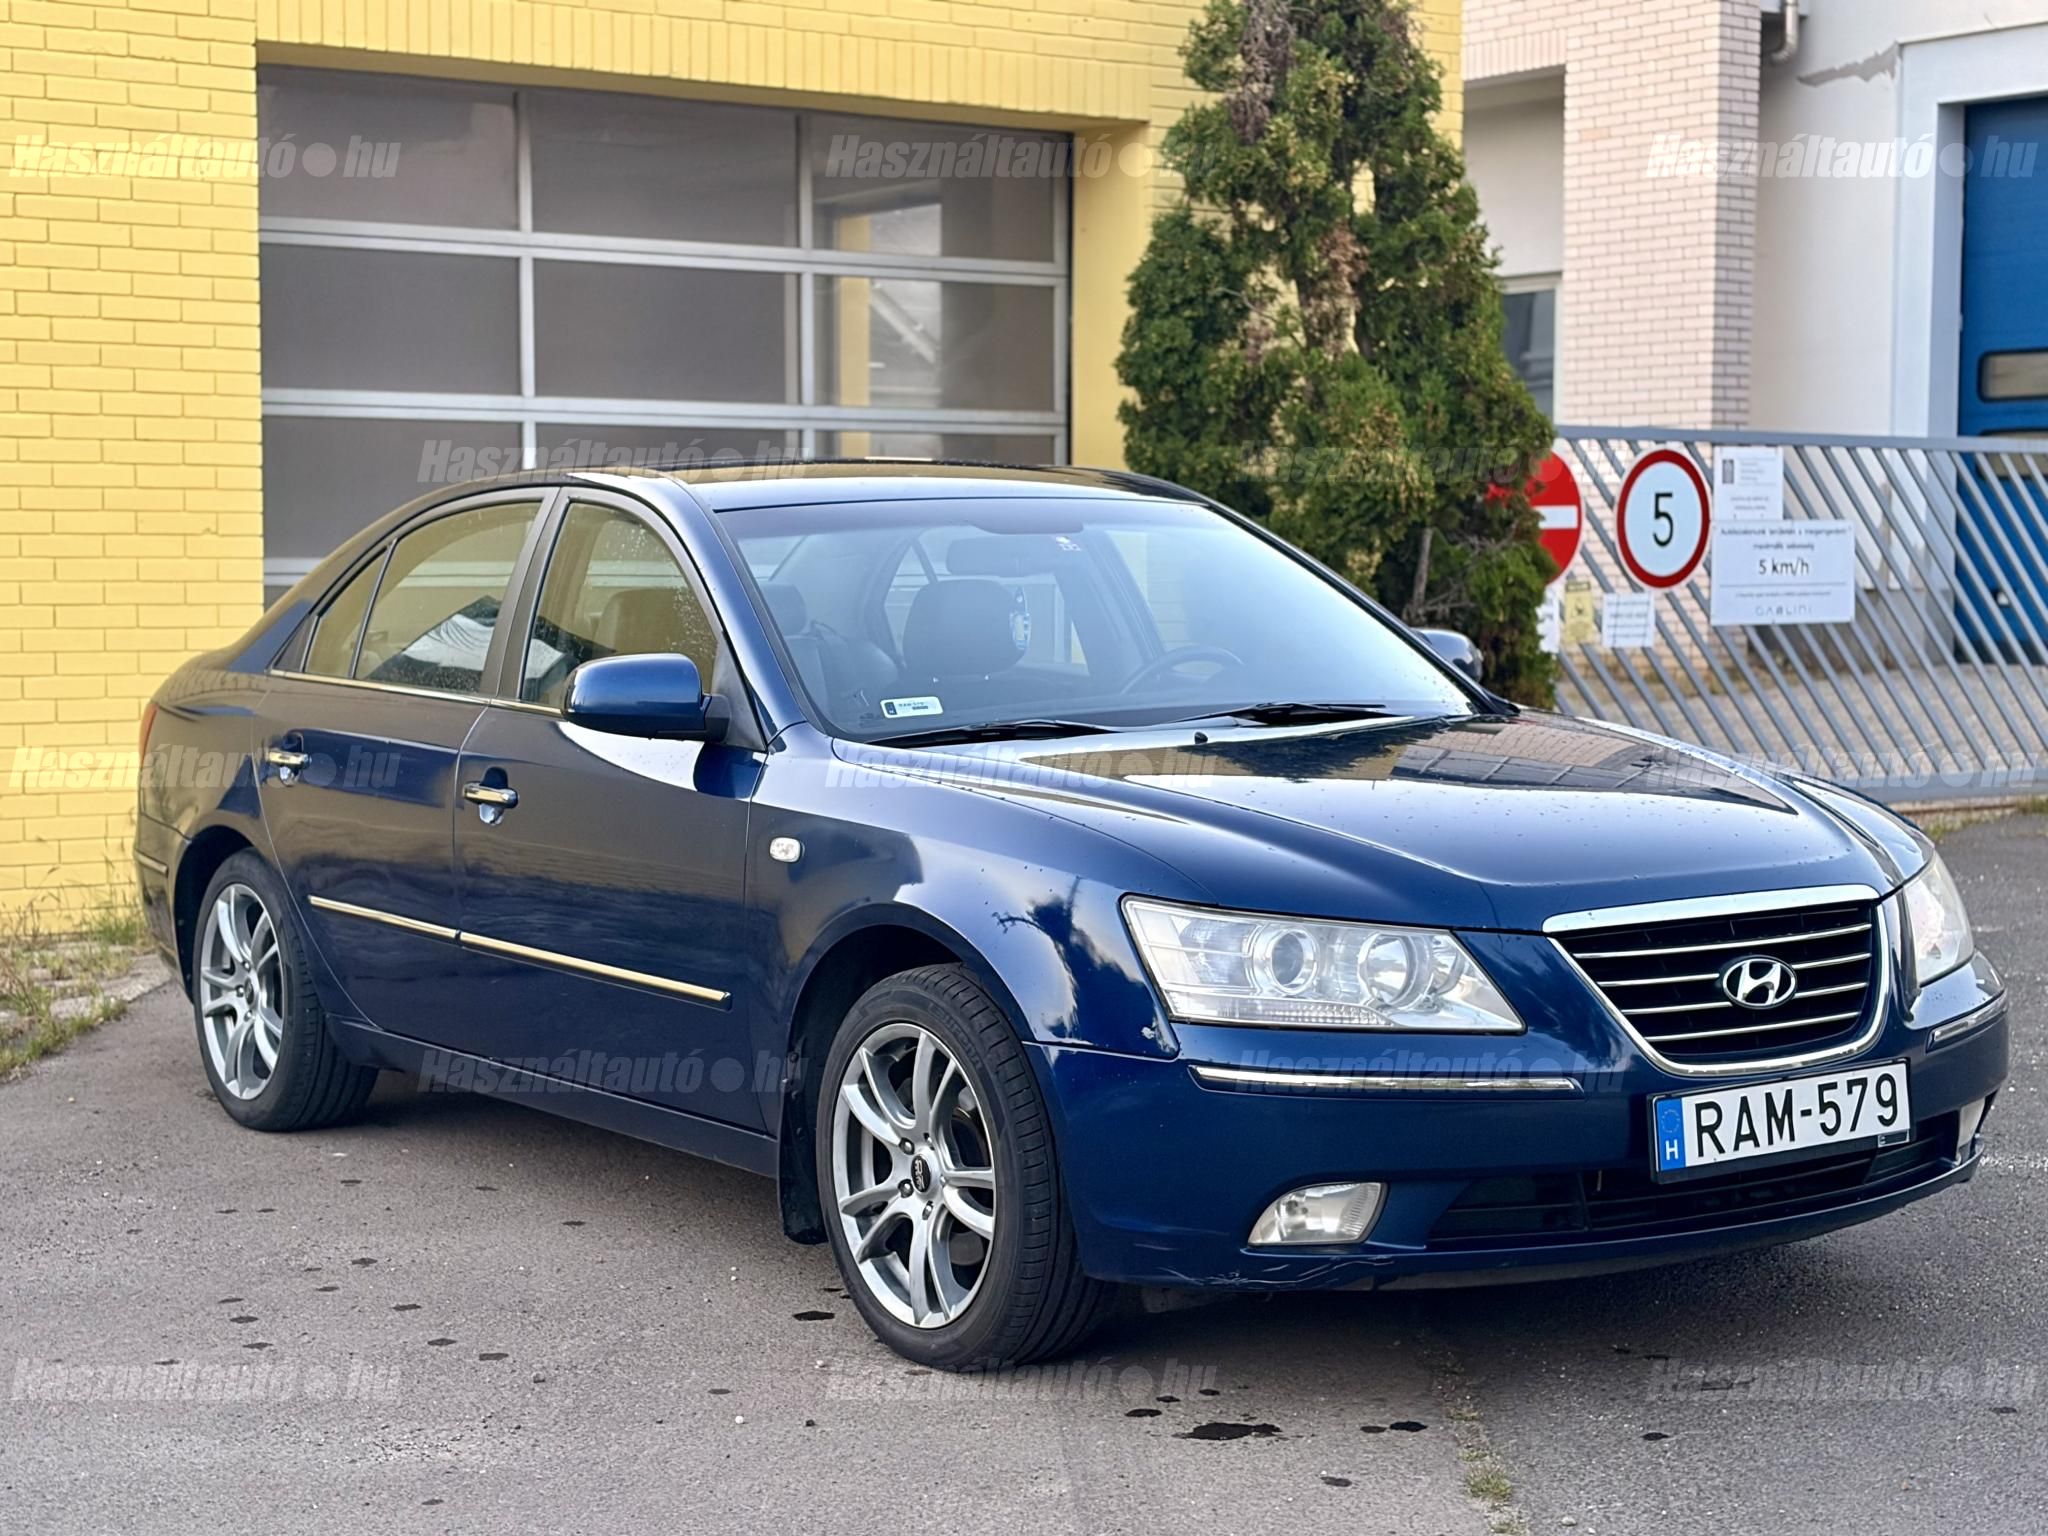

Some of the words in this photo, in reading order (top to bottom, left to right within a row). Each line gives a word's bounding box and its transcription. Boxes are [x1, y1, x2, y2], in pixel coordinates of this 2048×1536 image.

[1652, 492, 1674, 547] 5
[1758, 558, 1767, 575] 5
[1771, 557, 1810, 577] km/h
[1694, 1072, 1899, 1158] RAM-579
[1665, 1139, 1679, 1161] H
